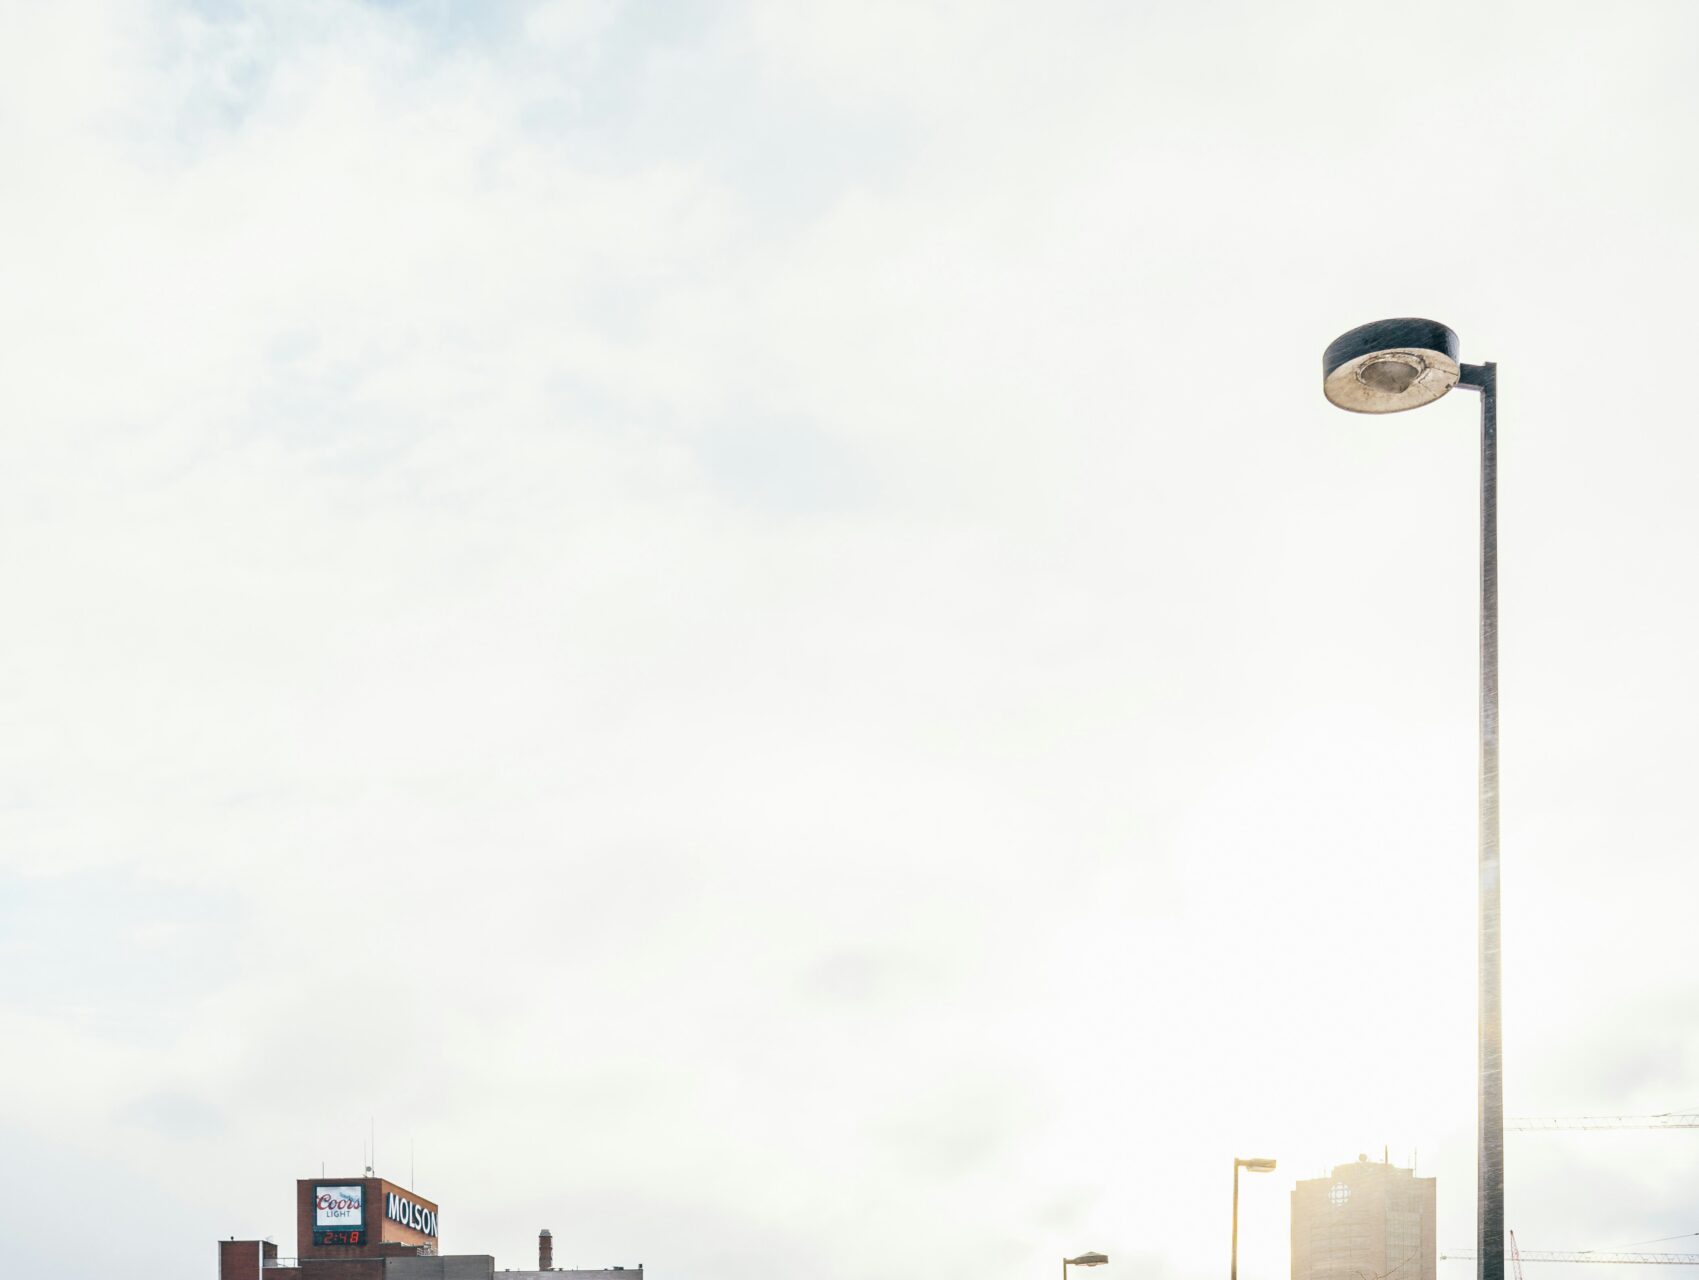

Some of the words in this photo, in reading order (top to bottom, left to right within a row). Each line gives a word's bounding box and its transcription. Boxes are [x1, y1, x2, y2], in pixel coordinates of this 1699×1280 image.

[317, 1194, 361, 1210] Coors
[326, 1210, 351, 1218] LIGHT
[388, 1192, 439, 1237] MOLSON
[323, 1231, 359, 1244] 2:48
